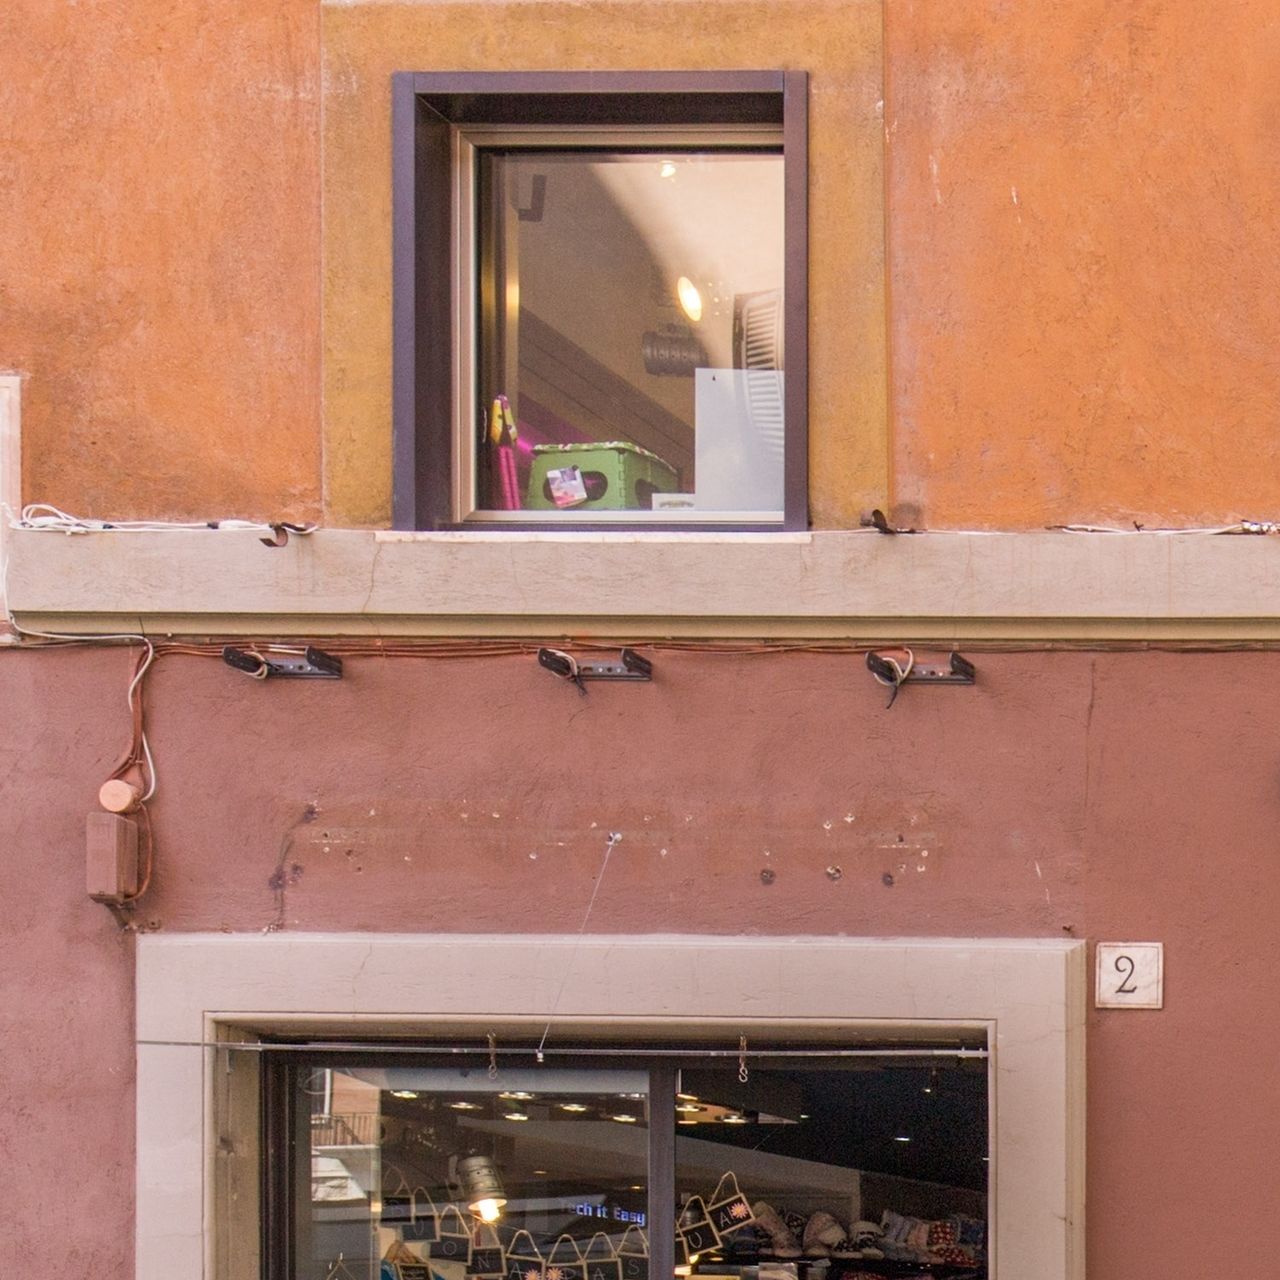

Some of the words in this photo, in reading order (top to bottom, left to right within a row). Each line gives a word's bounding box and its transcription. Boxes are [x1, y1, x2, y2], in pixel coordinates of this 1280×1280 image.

[1114, 955, 1137, 994] 2
[597, 1204, 608, 1219] it
[613, 1207, 645, 1226] Easy
